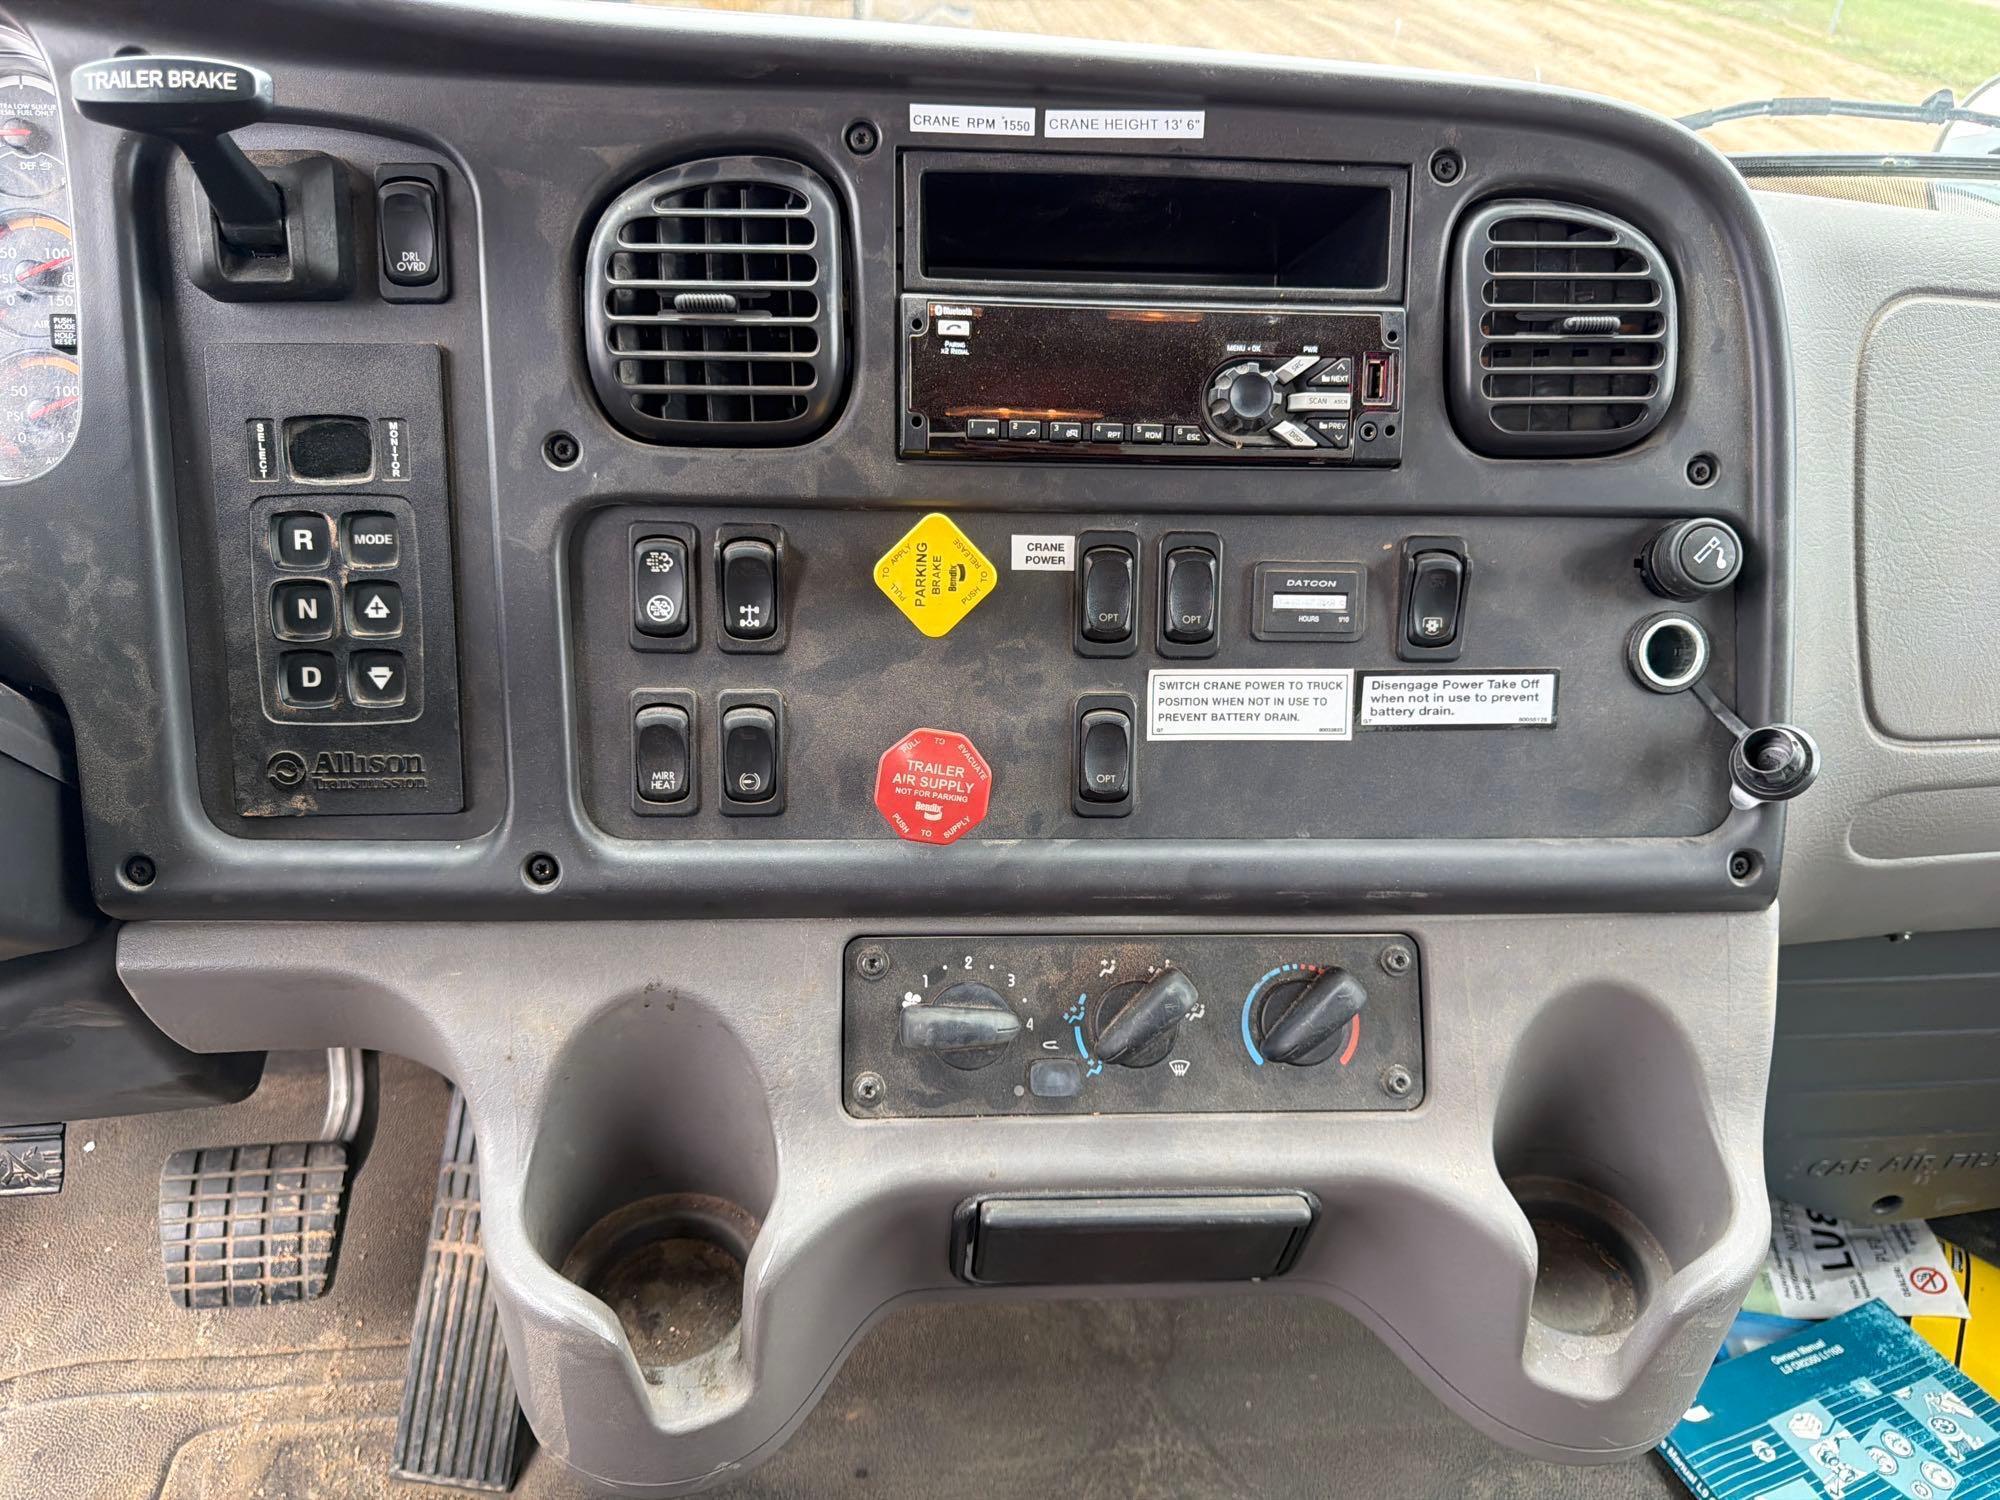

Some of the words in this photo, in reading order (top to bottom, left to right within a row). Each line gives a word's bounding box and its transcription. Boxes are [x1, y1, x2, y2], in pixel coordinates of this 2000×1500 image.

[85, 69, 164, 90] TRAILER
[168, 70, 238, 91] BRAKE
[913, 115, 960, 128] CRANE
[967, 117, 996, 130] RPM
[1049, 119, 1099, 130] CRANE
[1105, 119, 1158, 130] HEIGHT
[1164, 119, 1182, 130] 13'
[1187, 119, 1200, 130] 6"
[44, 247, 70, 260] 100
[402, 251, 420, 262] DRL
[396, 261, 426, 272] OVRD
[48, 295, 74, 307] 150
[53, 317, 75, 325] PUSH-
[55, 338, 77, 346] RESET
[1226, 343, 1246, 352] MENU
[1251, 344, 1262, 353] OK
[1303, 345, 1319, 353] PWR
[1291, 360, 1304, 373] SRC
[1330, 375, 1349, 383] NEXT
[10, 385, 28, 397] 50
[1308, 396, 1328, 405] SCAN
[6, 411, 25, 422] PSI
[1012, 422, 1019, 430] 2
[1053, 424, 1060, 432] 3
[1328, 422, 1347, 430] PREV
[1107, 431, 1121, 439] RPT
[1186, 433, 1201, 441] ESC
[1288, 430, 1305, 443] DISP
[256, 423, 268, 478] SELECT
[388, 421, 401, 478] MONITOR
[293, 529, 313, 551] R
[354, 533, 394, 545] MODE
[1026, 542, 1065, 552] CRANE
[890, 543, 911, 566] APPLY
[952, 538, 982, 570] RELEASE
[1025, 555, 1066, 565] POWER
[882, 566, 890, 579] TO
[915, 542, 928, 607] PARKING
[932, 555, 942, 595] BRAKE
[948, 564, 957, 592] Bendix
[980, 571, 988, 583] TO
[1286, 579, 1337, 588] DATCON
[890, 583, 907, 602] PULL
[961, 586, 981, 605] PUSH
[298, 598, 318, 619] N
[1098, 612, 1119, 622] OPT
[1182, 615, 1202, 625] OPT
[1298, 615, 1320, 623] HOURS
[302, 666, 322, 688] D
[1158, 681, 1200, 690] SWITCH
[1203, 681, 1242, 690] CRANE
[1245, 681, 1285, 690] POWER
[1289, 681, 1303, 690] TO
[1307, 681, 1343, 690] TRUCK
[1371, 680, 1438, 692] Disengage
[1442, 680, 1482, 690] Power
[1487, 679, 1517, 689] Take
[1520, 679, 1540, 689] Off
[1158, 697, 1209, 707] POSITION
[1212, 697, 1244, 706] WHEN
[1248, 697, 1270, 706] NOT
[1273, 697, 1284, 706] IN
[1288, 697, 1310, 706] USE
[1314, 697, 1328, 706] TO
[1370, 693, 1404, 703] when
[1408, 693, 1429, 703] not
[1433, 693, 1444, 703] in
[1448, 694, 1471, 702] use
[1475, 693, 1488, 702] to
[1491, 692, 1539, 704] prevent
[1158, 713, 1208, 722] PREVENT
[1211, 713, 1261, 722] BATTERY
[1264, 713, 1300, 722] DRAIN.
[1370, 706, 1414, 718] battery
[1418, 706, 1455, 716] drain.
[311, 751, 426, 774] Allison
[900, 737, 921, 754] PULL
[934, 737, 946, 745] TO
[957, 743, 989, 781] EVACUATE
[907, 759, 965, 779] TRAILER
[652, 771, 675, 780] MIRR
[1096, 774, 1116, 783] OPT
[651, 780, 676, 790] HEAT
[892, 773, 916, 786] AIR
[920, 776, 975, 794] SUPPLY
[895, 787, 912, 795] NOT
[913, 789, 931, 798] FOR
[932, 792, 968, 803] PARKING
[915, 801, 943, 813] Bendix
[892, 812, 911, 834] PUSH
[921, 829, 932, 837] TO
[943, 816, 971, 839] SUPPLY
[964, 955, 973, 970] 2
[922, 974, 928, 988] 1
[1007, 973, 1015, 987] 3
[1026, 1017, 1034, 1031] 4
[1666, 1446, 1698, 1485] Manual
